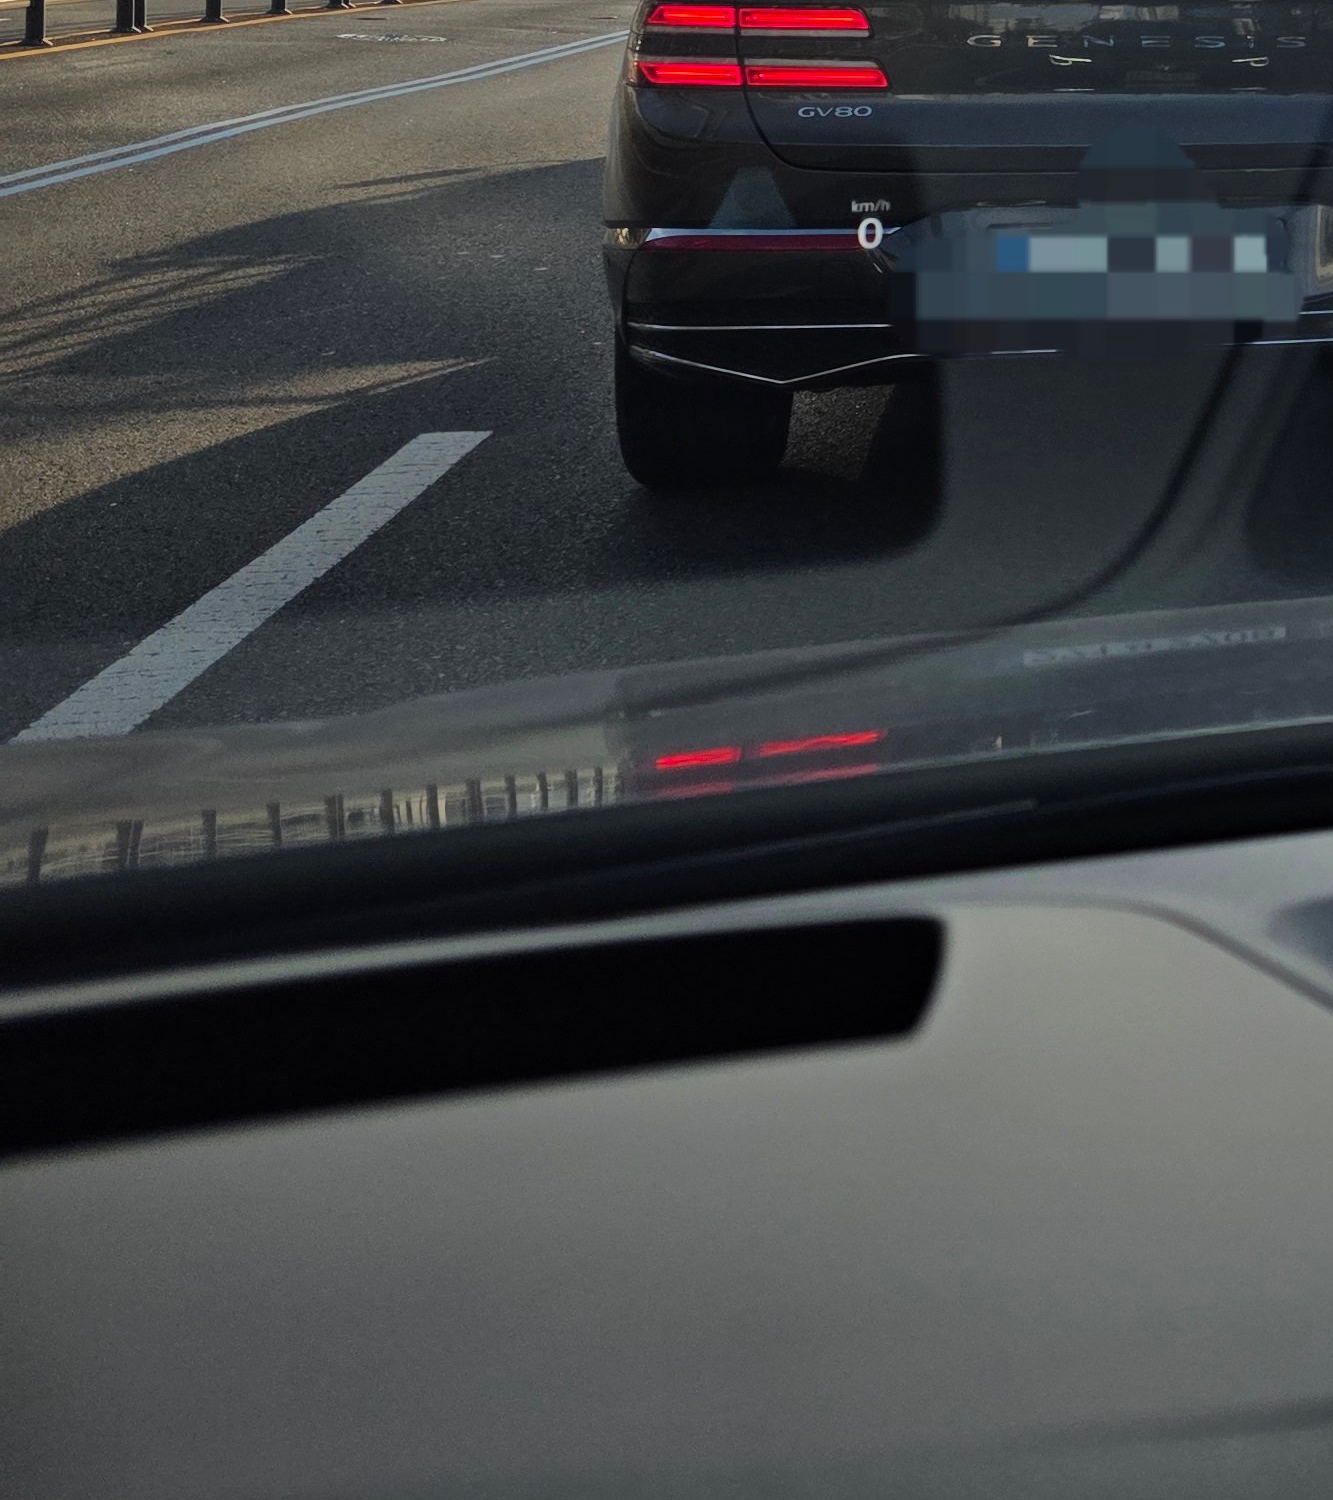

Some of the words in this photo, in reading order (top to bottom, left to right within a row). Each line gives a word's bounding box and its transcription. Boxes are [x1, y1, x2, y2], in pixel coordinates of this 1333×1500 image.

[966, 33, 1307, 49] GENESIS
[798, 105, 873, 118] GV80
[851, 199, 892, 213] km/h
[857, 217, 884, 250] 0
